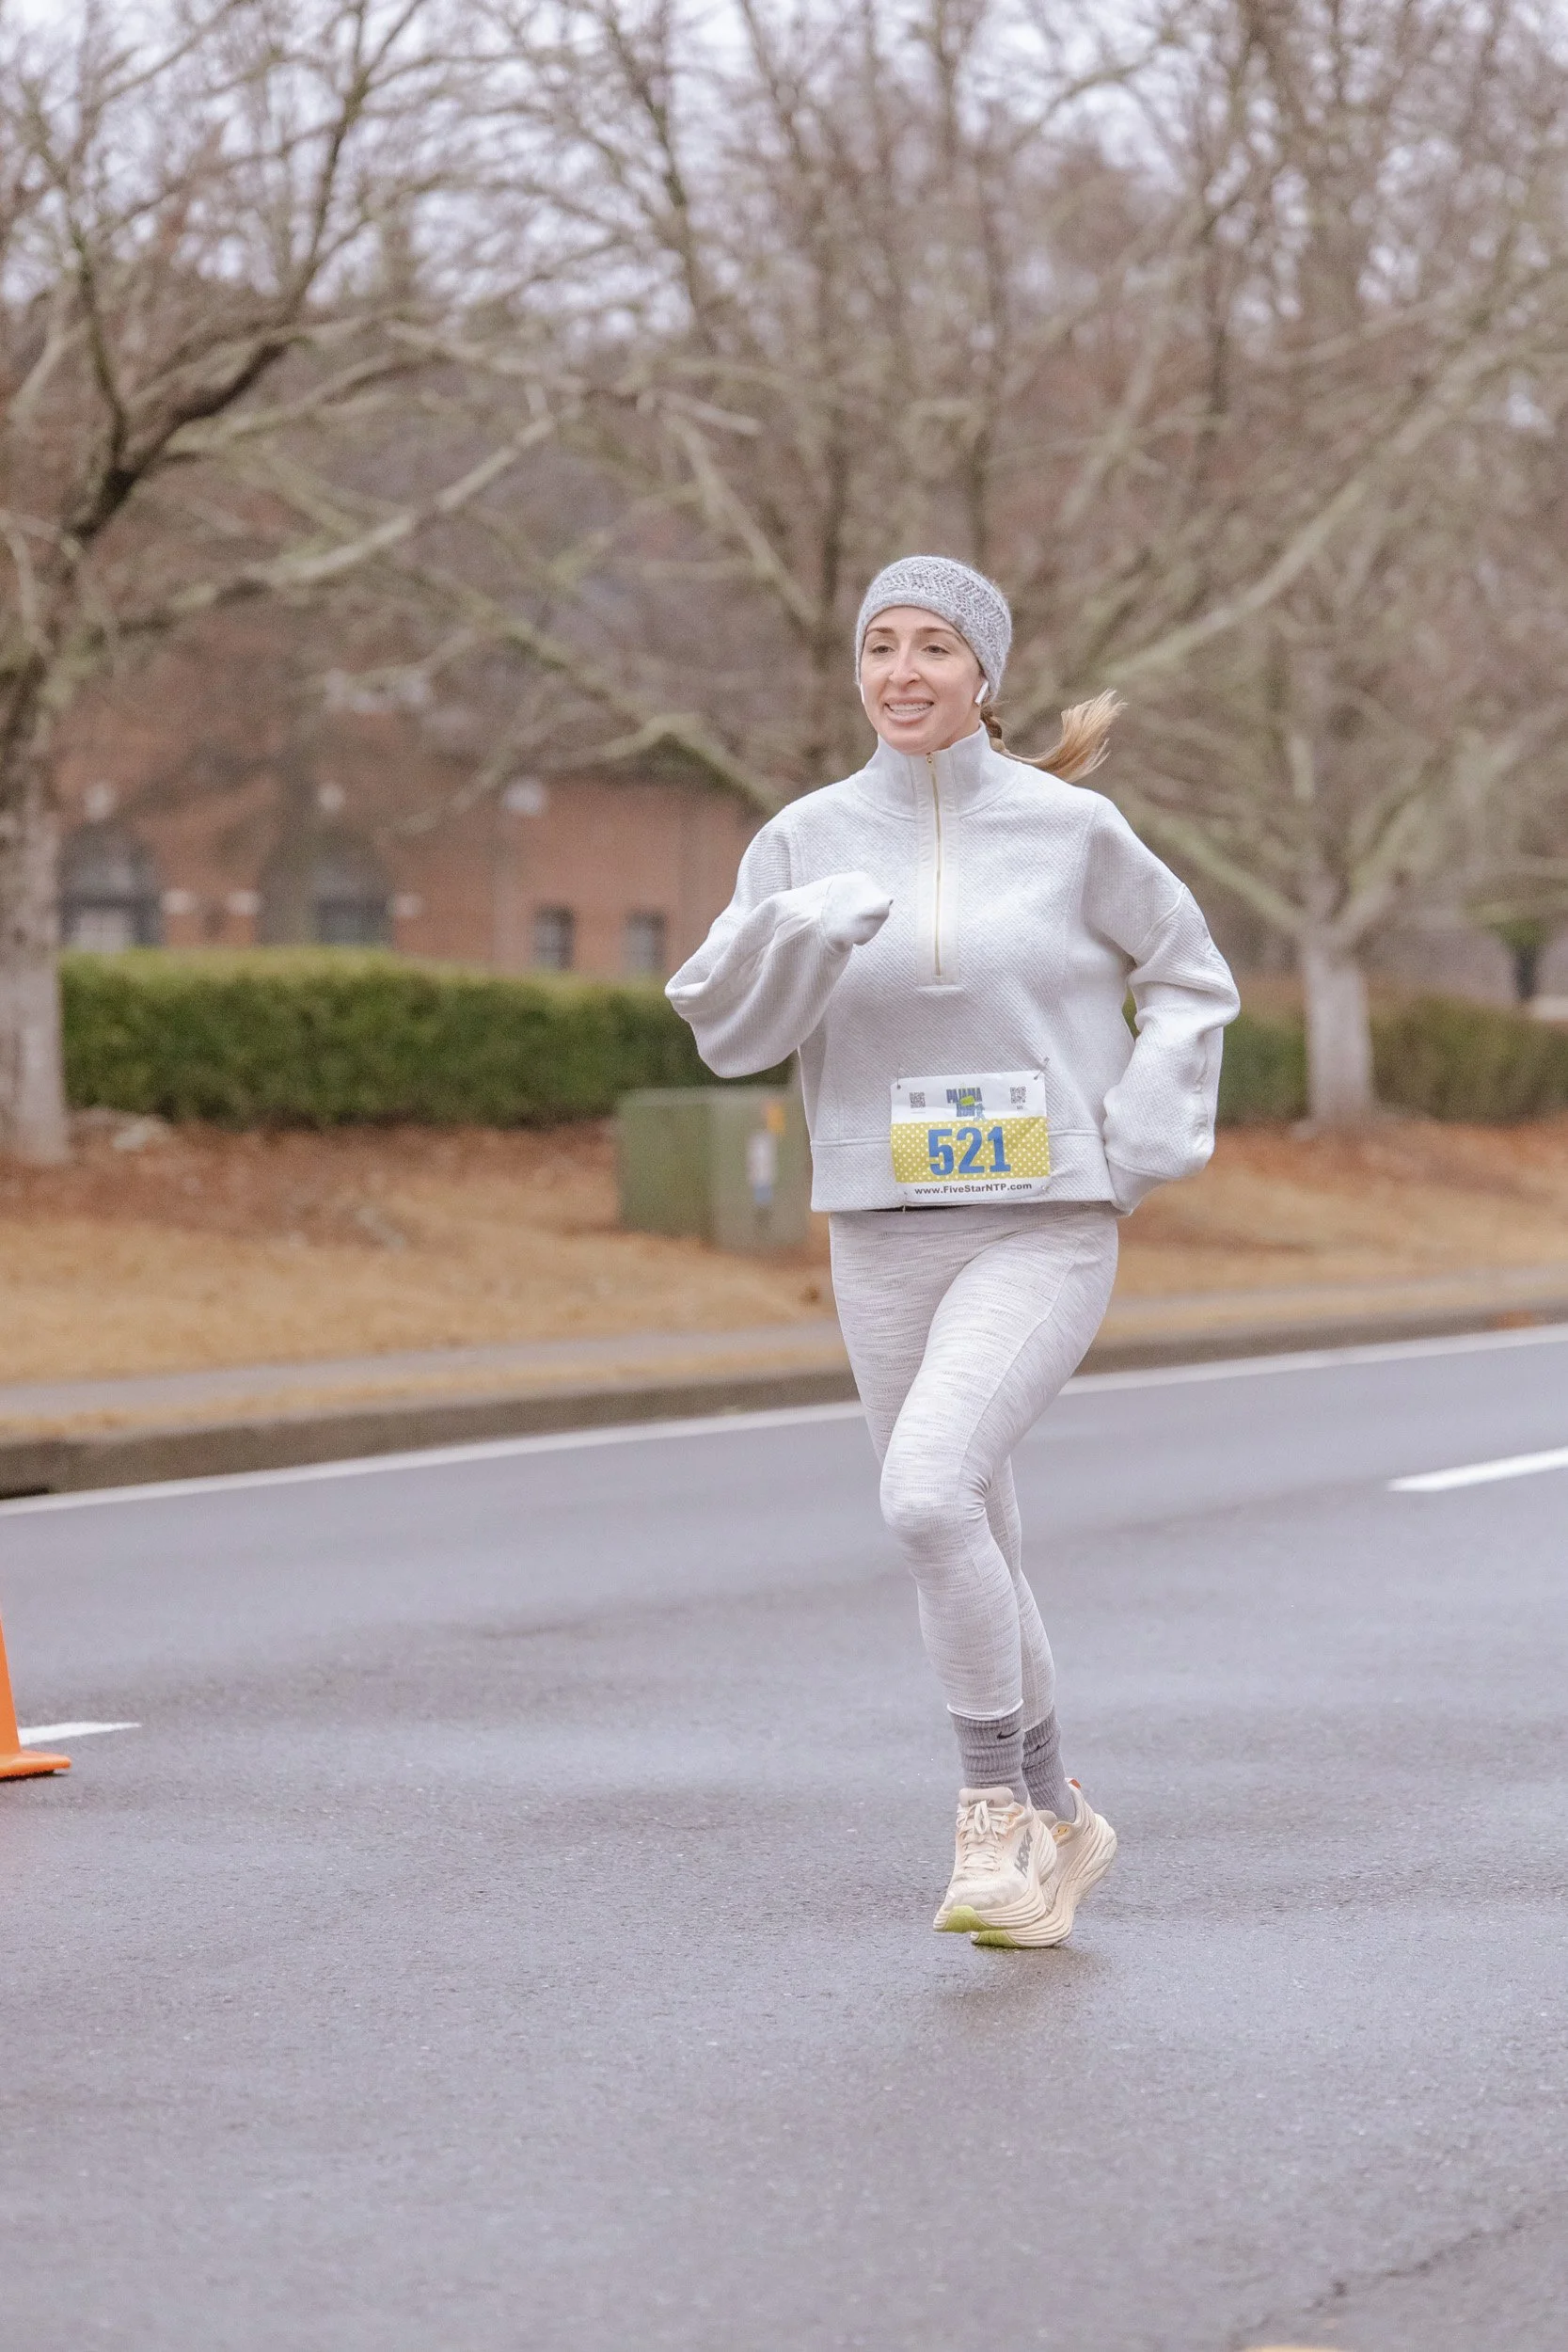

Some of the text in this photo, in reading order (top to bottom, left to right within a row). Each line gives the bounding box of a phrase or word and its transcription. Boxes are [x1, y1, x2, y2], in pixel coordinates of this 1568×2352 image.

[927, 1126, 1011, 1176] 521
[914, 1183, 1033, 1195] www.FiveStarNTP.com
[1014, 1828, 1034, 1879] HOKA
